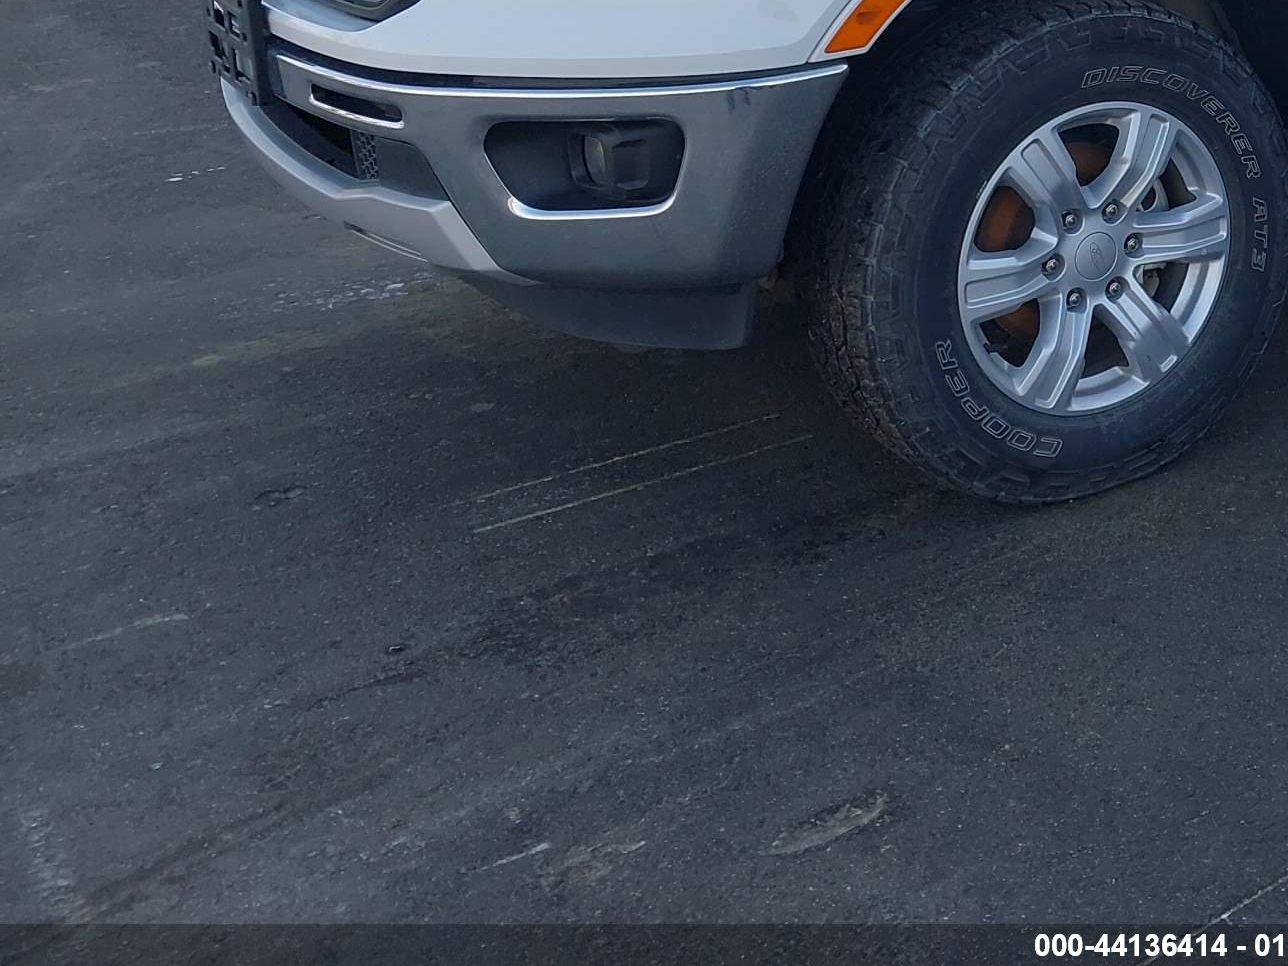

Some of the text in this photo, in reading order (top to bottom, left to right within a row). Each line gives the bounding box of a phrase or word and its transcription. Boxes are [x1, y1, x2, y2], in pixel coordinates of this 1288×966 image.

[1080, 64, 1271, 274] DISCOVERER AT3
[930, 337, 1064, 459] COOPER
